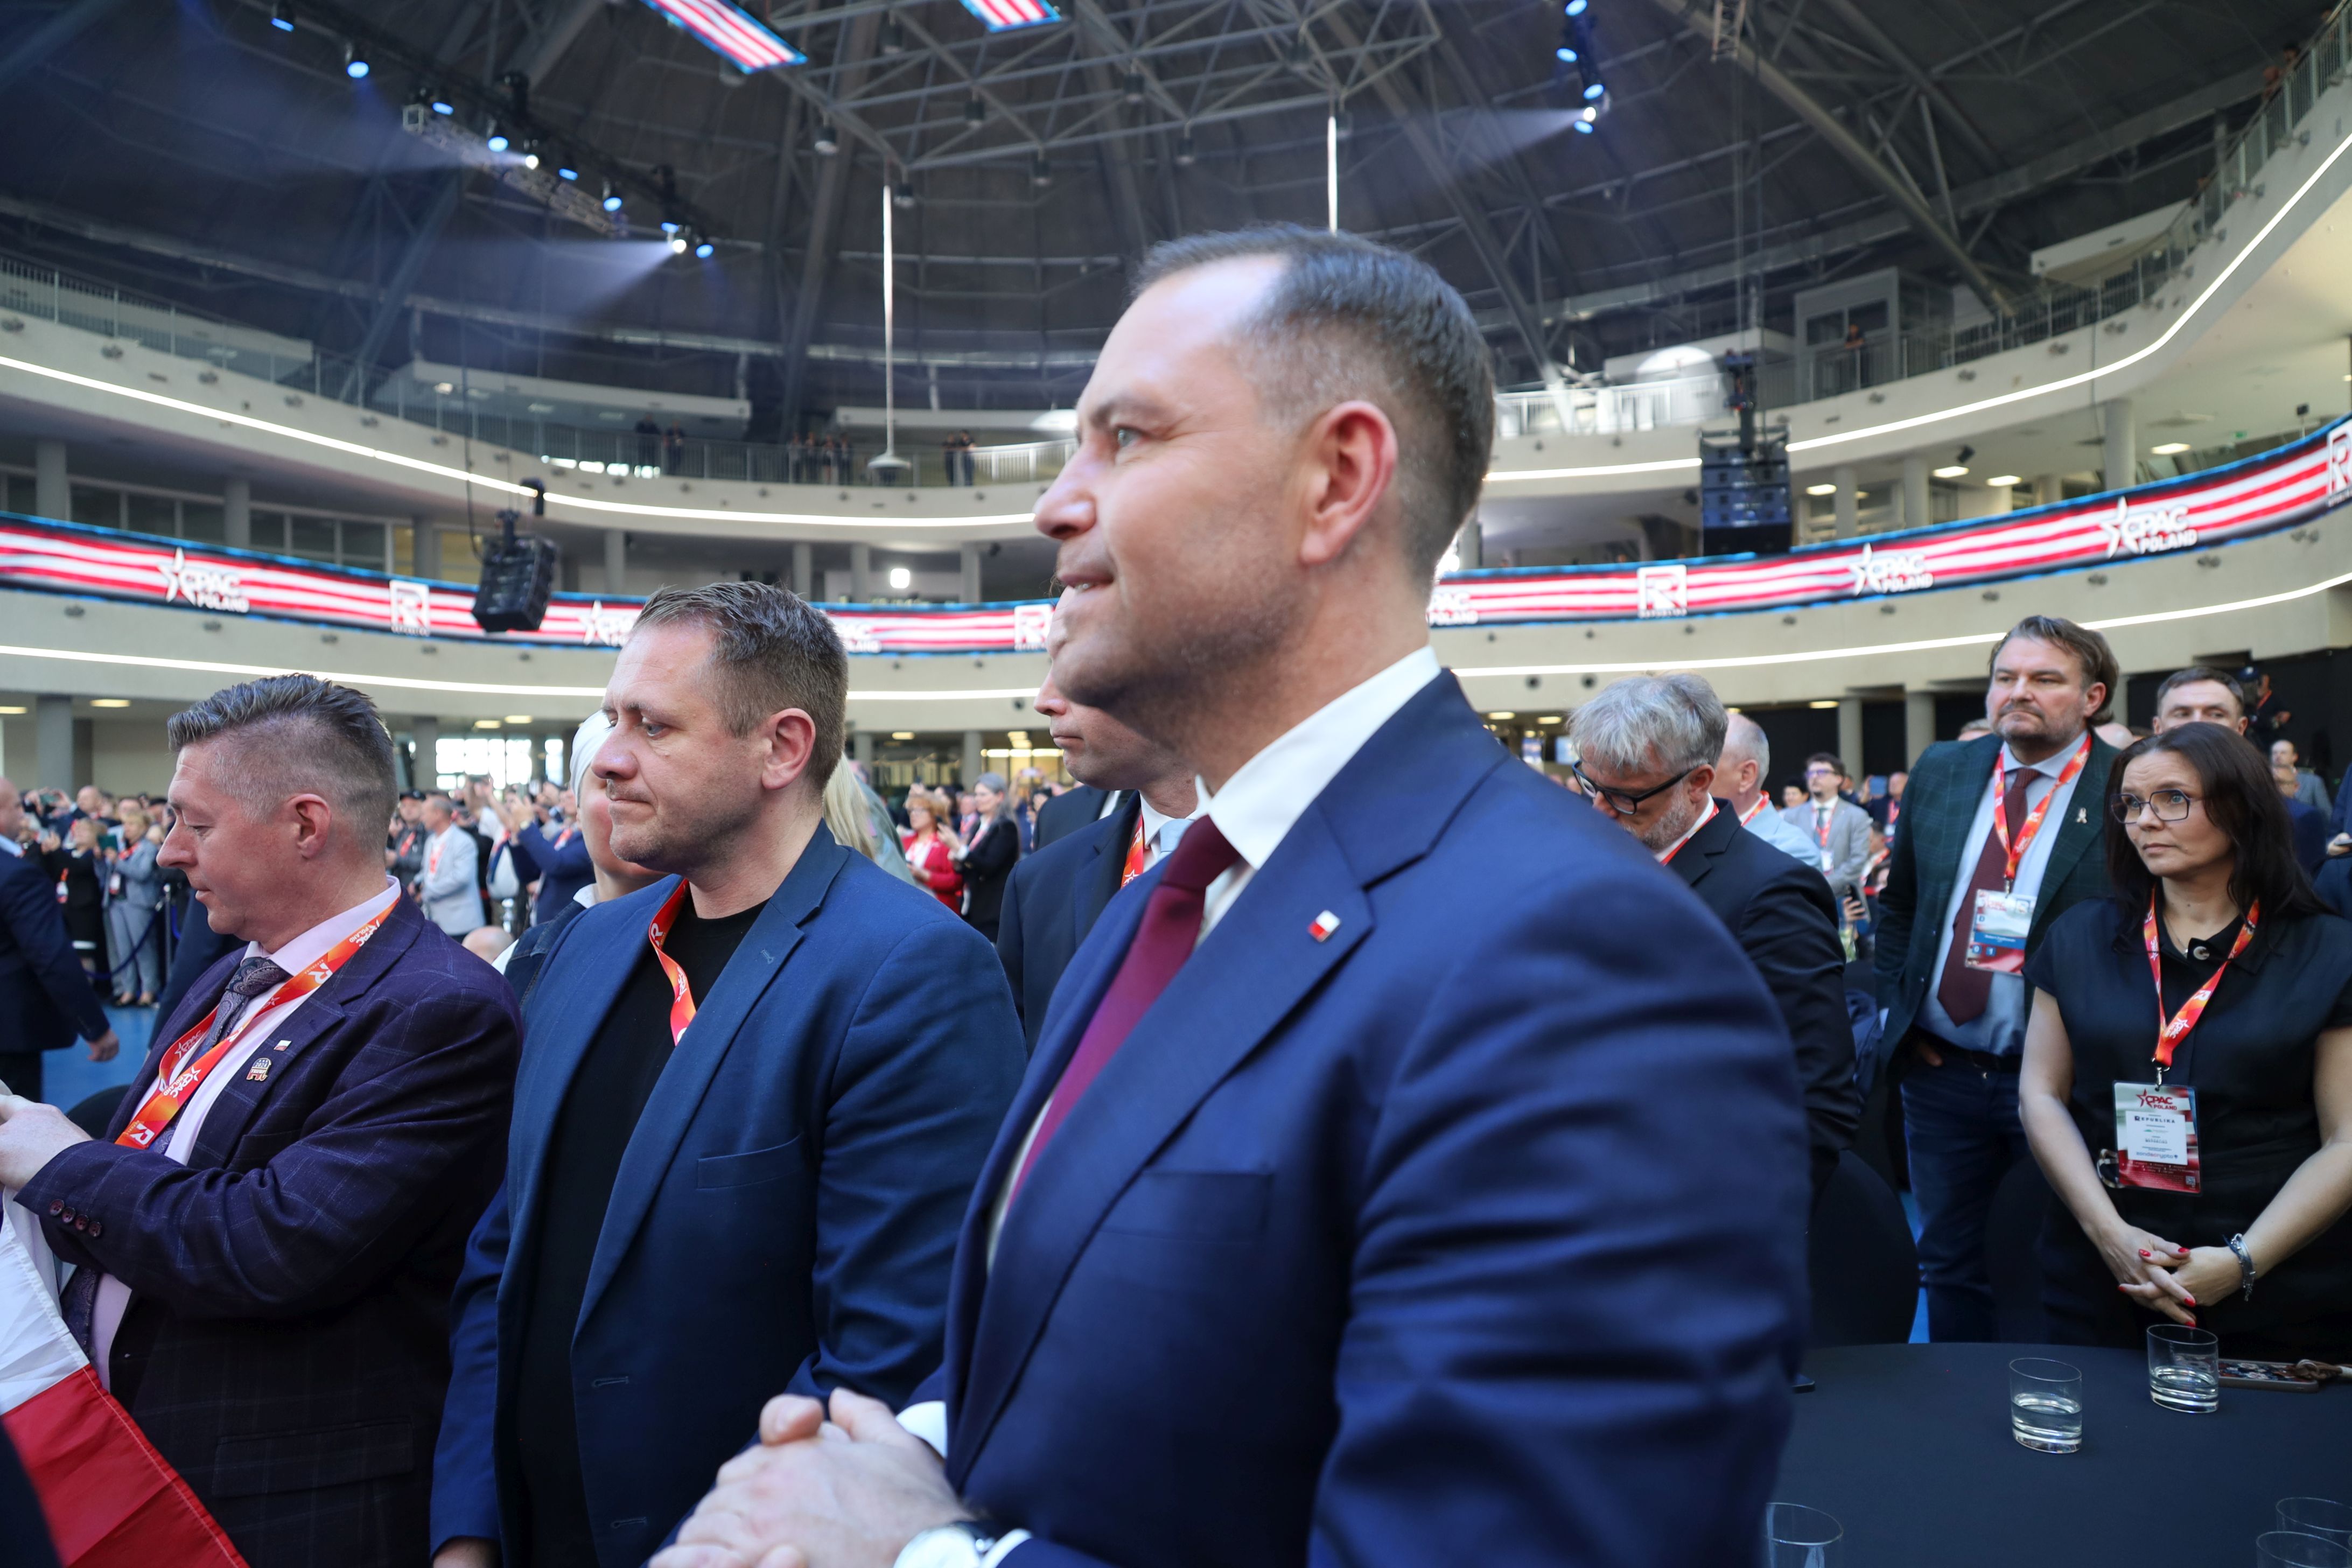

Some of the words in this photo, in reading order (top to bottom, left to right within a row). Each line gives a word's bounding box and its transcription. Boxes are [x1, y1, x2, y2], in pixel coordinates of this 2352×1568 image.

[2121, 505, 2189, 538] CPAC
[2139, 528, 2198, 555] POLAND
[1867, 554, 1925, 580] CPAC
[179, 569, 241, 598] CPAC
[1881, 572, 1934, 593] POLAND
[197, 592, 250, 613] POLAND
[1430, 592, 1472, 609] PAC
[349, 926, 370, 943] POLAND
[307, 962, 333, 985] R
[163, 1076, 184, 1096] POLAND
[169, 1072, 194, 1098] CPAC
[2146, 1095, 2173, 1105] CPAC
[2134, 1116, 2175, 1124] REPUBLIKA
[129, 1123, 155, 1145] R
